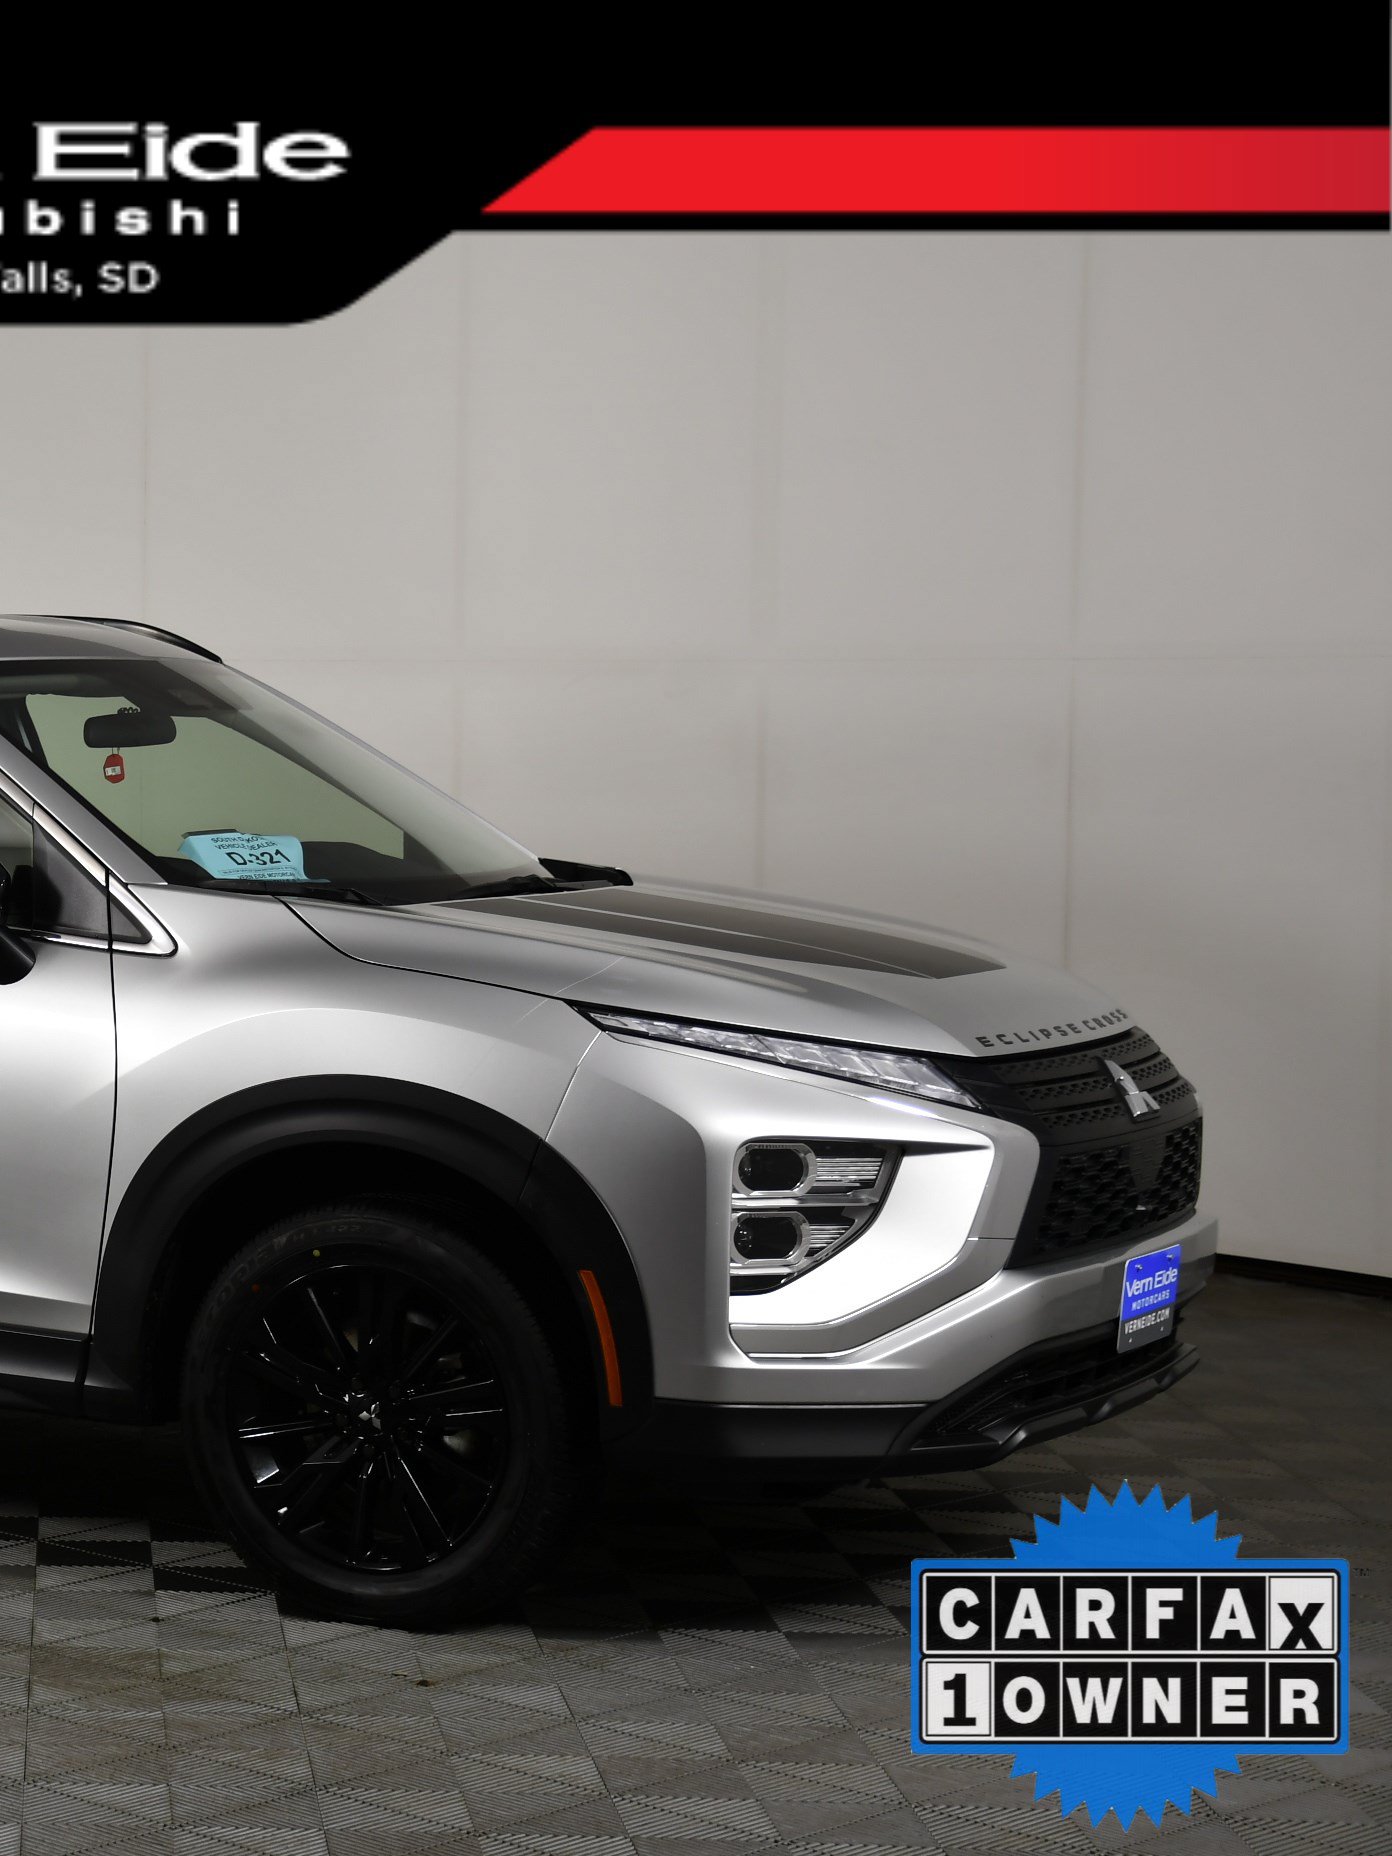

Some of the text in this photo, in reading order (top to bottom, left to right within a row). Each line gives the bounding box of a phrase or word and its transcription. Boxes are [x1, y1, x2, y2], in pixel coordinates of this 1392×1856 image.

[225, 849, 291, 866] D-321
[975, 1008, 1129, 1048] ECLIPSE CROSS
[1125, 1266, 1179, 1298] Vern Eide
[1131, 1289, 1171, 1312] MOTORCARS
[1124, 1307, 1171, 1335] VERNEIDE.COM
